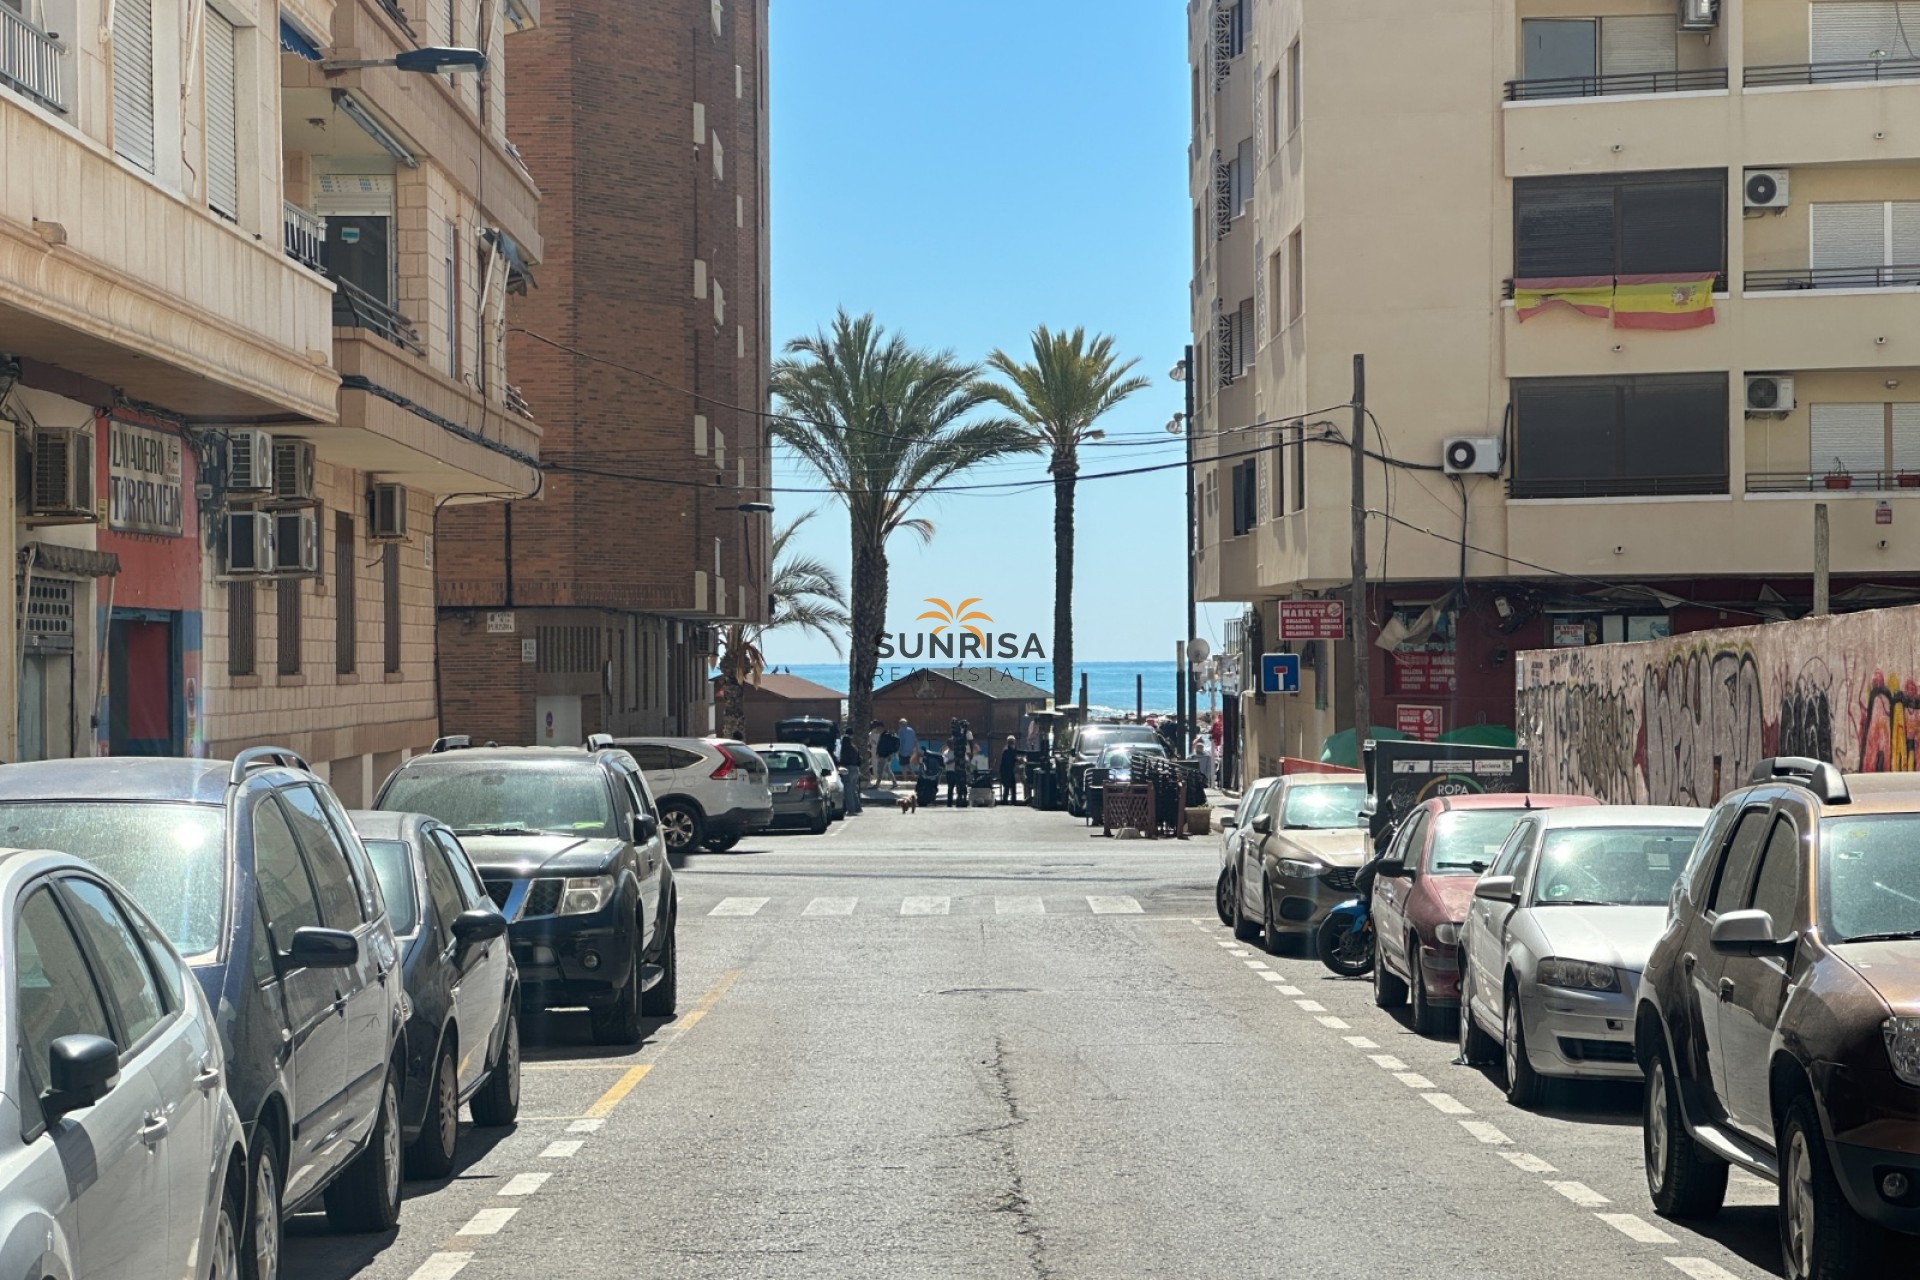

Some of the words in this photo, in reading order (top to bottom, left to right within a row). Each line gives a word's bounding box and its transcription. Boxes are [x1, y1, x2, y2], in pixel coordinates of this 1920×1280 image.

[113, 430, 164, 475] LAVADERO
[111, 476, 181, 527] TORREVIEJA
[1282, 609, 1326, 617] MARKET
[1437, 784, 1469, 795] ROPA
